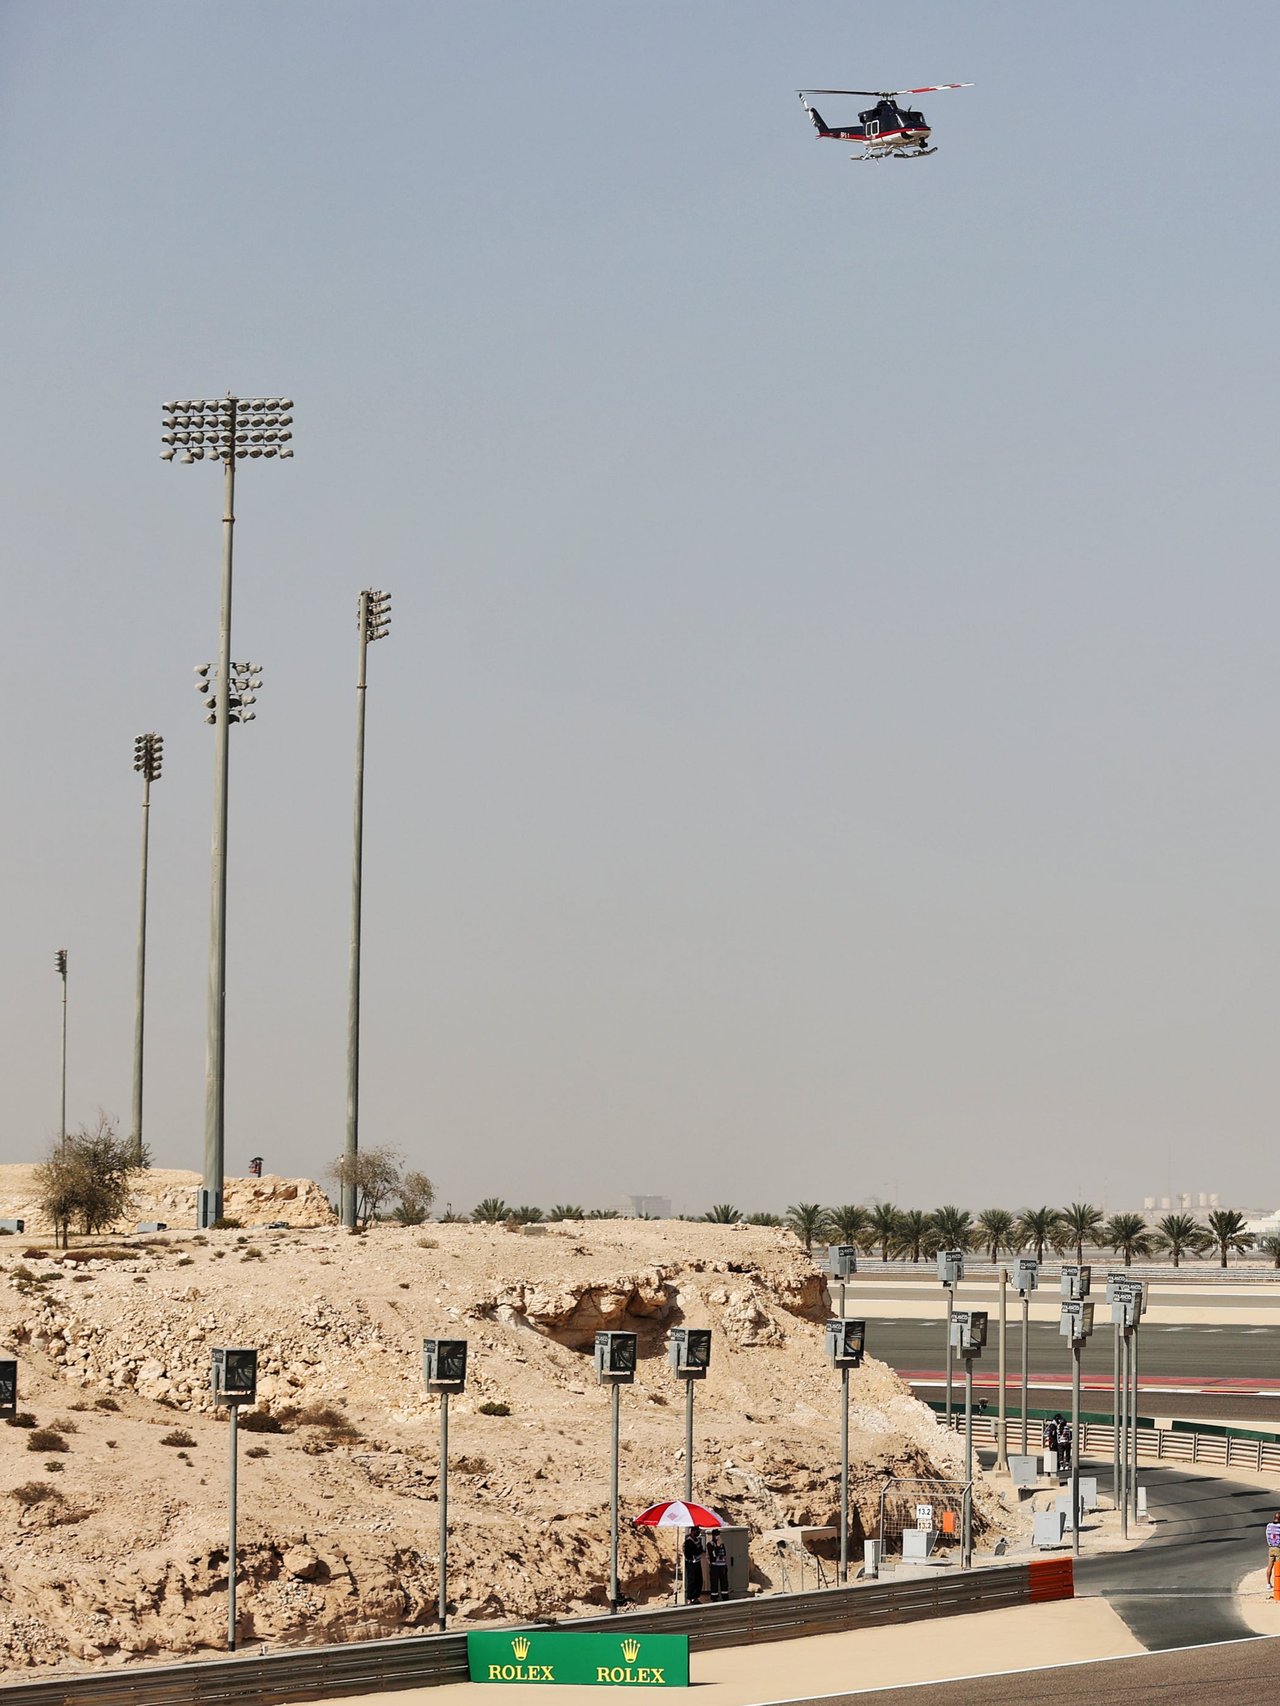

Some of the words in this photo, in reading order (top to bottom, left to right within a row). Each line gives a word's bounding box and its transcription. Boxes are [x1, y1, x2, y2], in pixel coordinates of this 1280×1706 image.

[918, 1508, 931, 1516] 13.2
[488, 1665, 555, 1681] ROLEX
[597, 1667, 665, 1684] ROLEX
